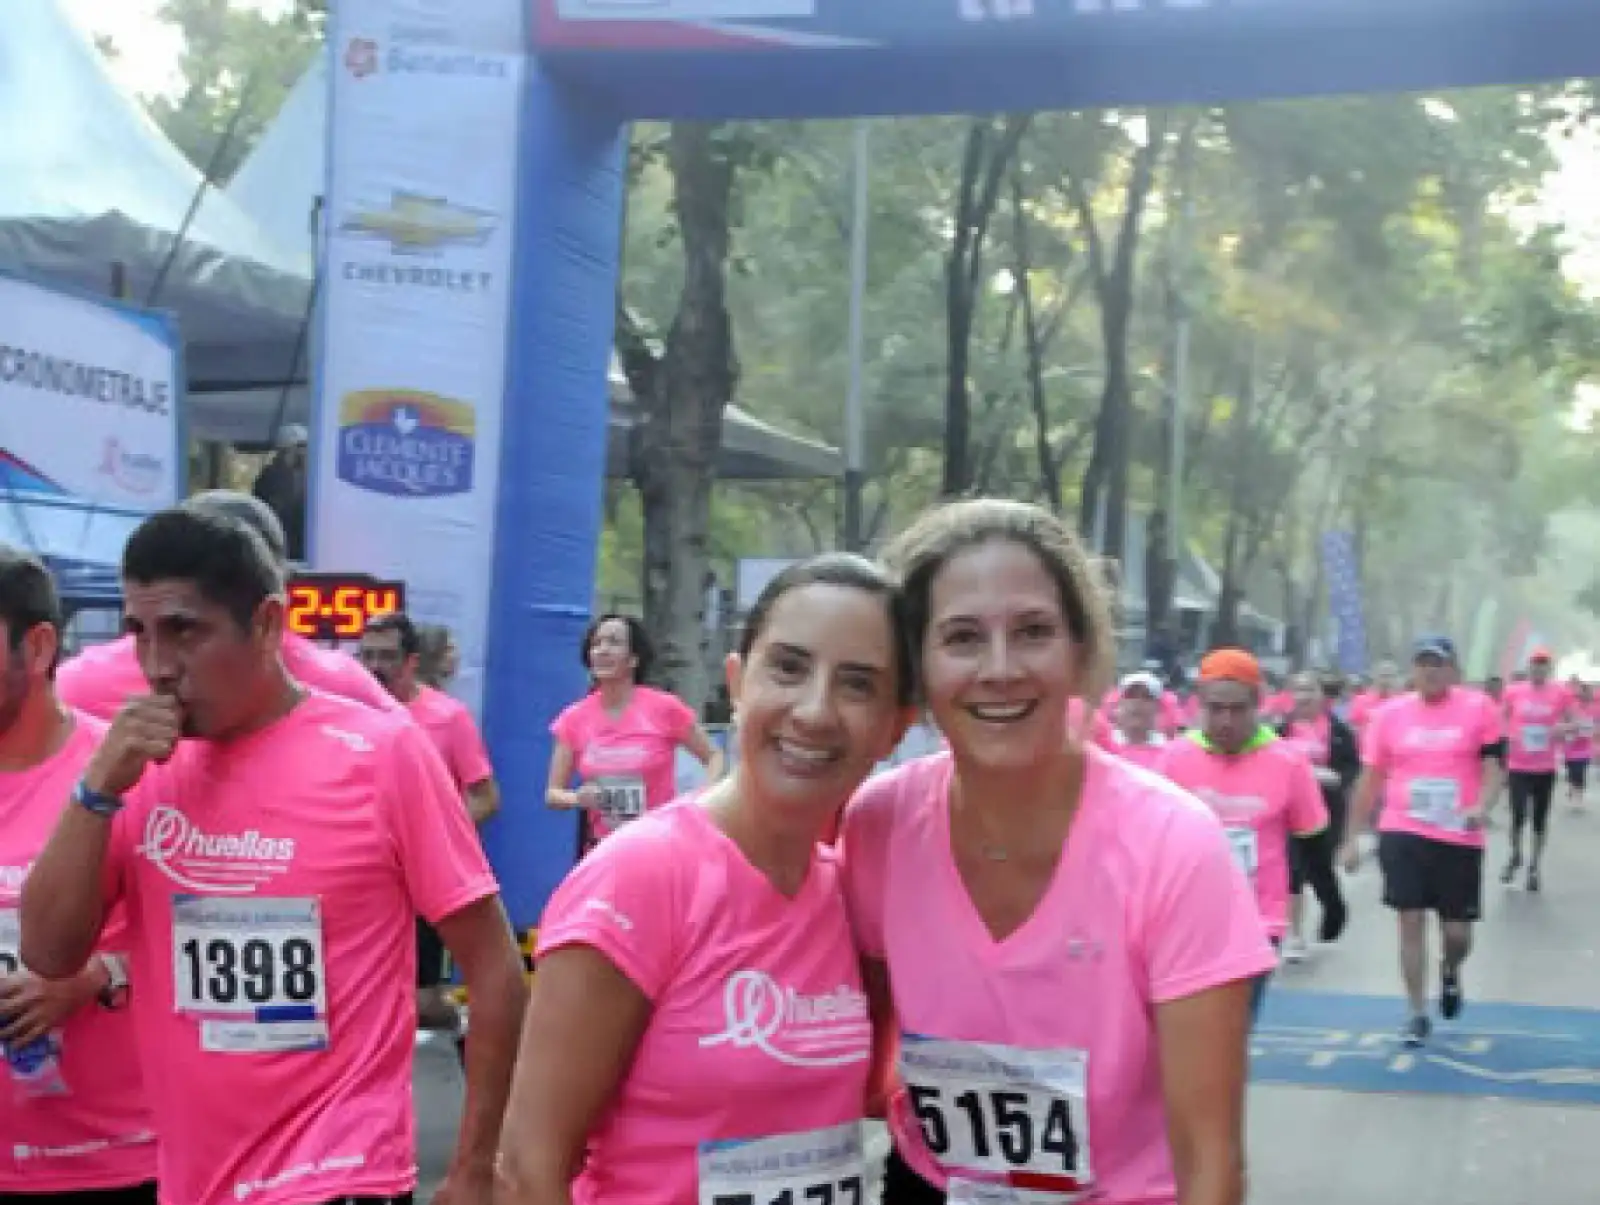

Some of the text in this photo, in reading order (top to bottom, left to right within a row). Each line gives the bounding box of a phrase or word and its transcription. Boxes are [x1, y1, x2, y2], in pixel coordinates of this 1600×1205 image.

[343, 261, 492, 290] CHEVROLET
[0, 345, 169, 416] CRONOMETRAJE
[345, 431, 466, 466] CLEMENTE
[355, 459, 457, 492] JACQUES
[181, 937, 317, 1003] 1398
[907, 1083, 1080, 1171] 5154
